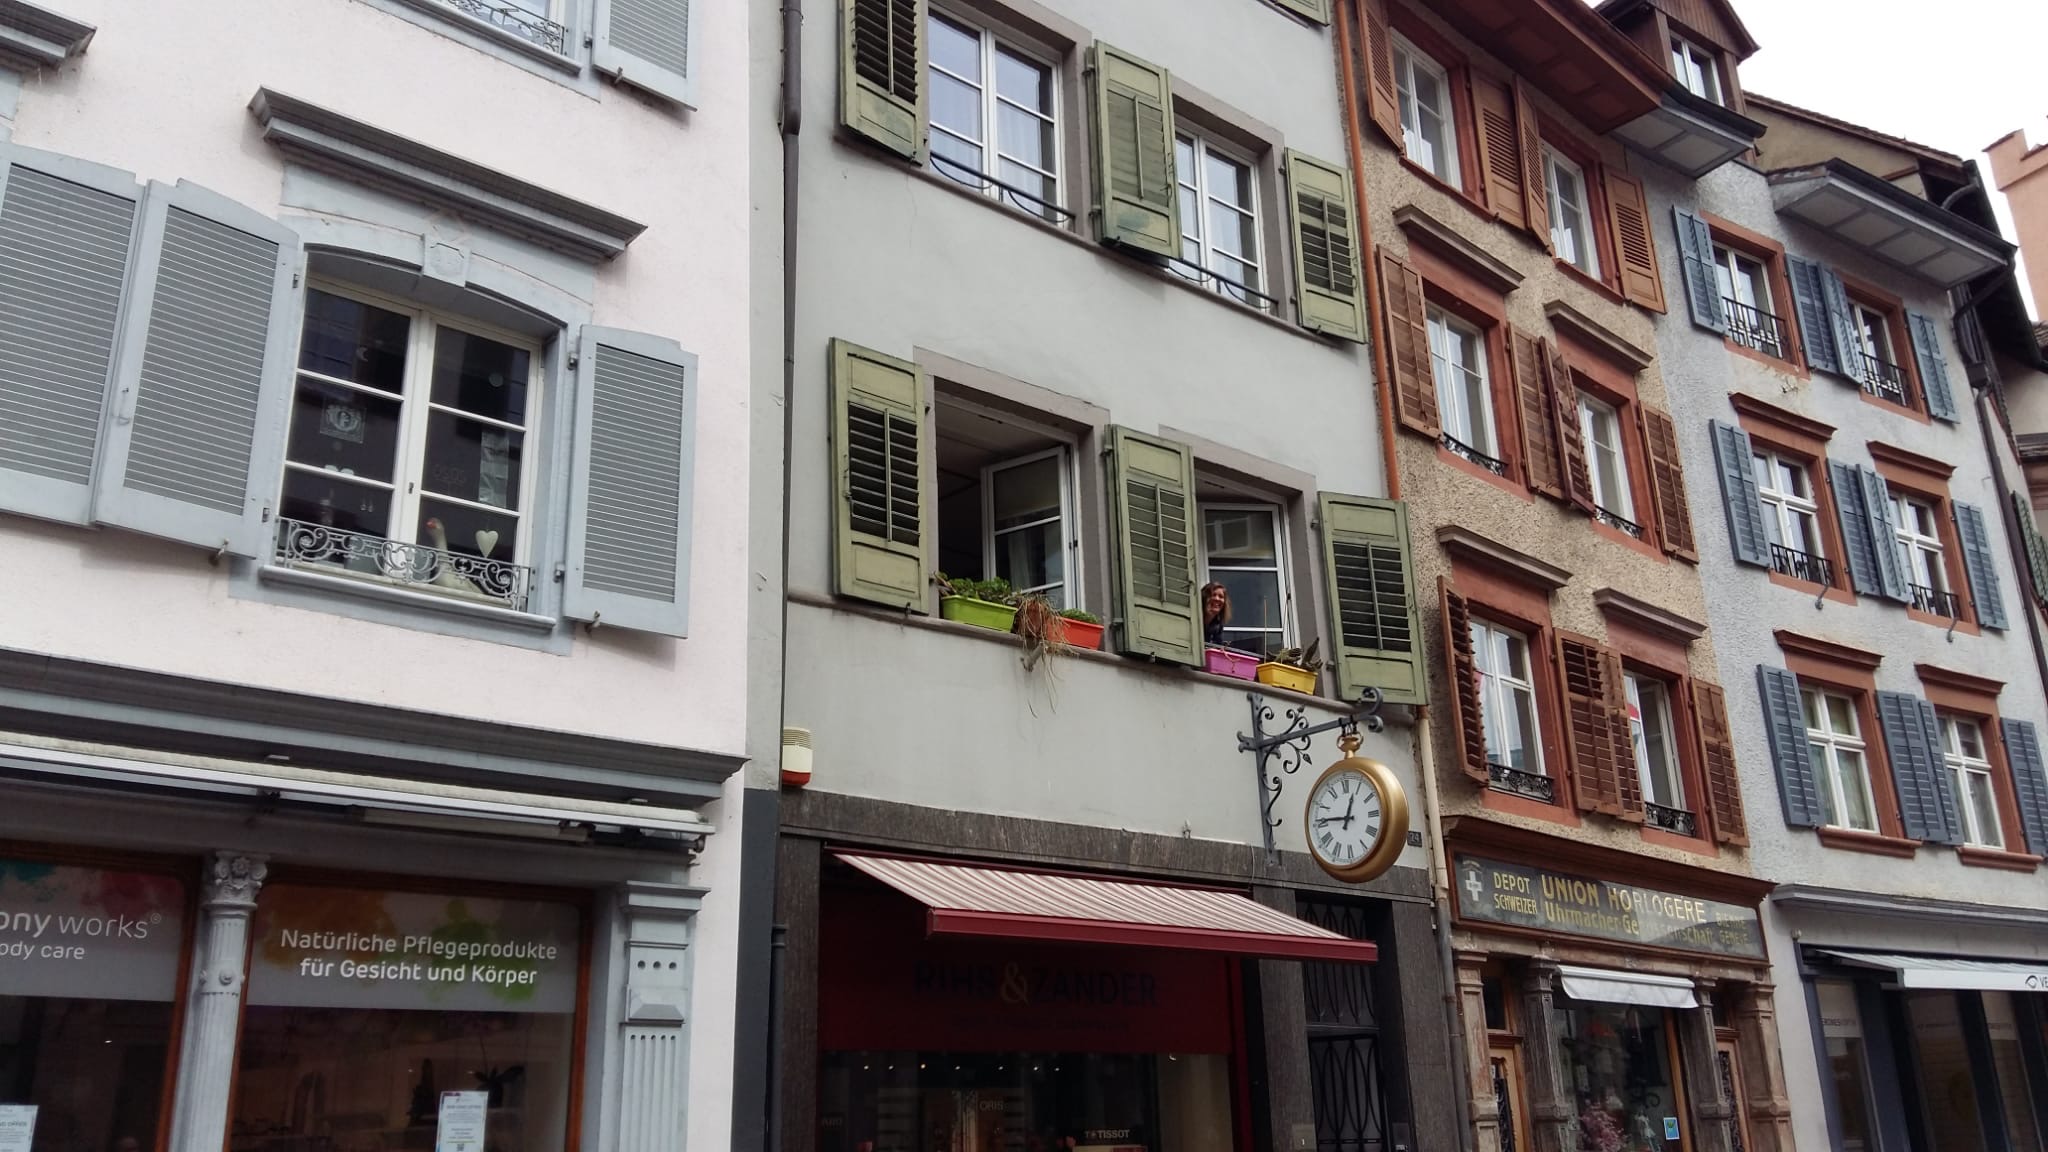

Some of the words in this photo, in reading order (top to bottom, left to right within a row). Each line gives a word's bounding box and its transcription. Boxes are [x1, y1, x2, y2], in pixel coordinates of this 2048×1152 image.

[1493, 871, 1530, 895] DEPOT
[1541, 873, 1600, 908] UNION
[1493, 893, 1538, 915] SCHWEIZER
[40, 944, 86, 961] care
[280, 928, 397, 954] Natürliche
[402, 935, 558, 961] Pflegeprodukte
[299, 957, 335, 977] für
[339, 959, 422, 981] Gesicht
[427, 963, 467, 983] und
[471, 964, 538, 988] Körper
[1097, 1129, 1130, 1139] TISSOT
